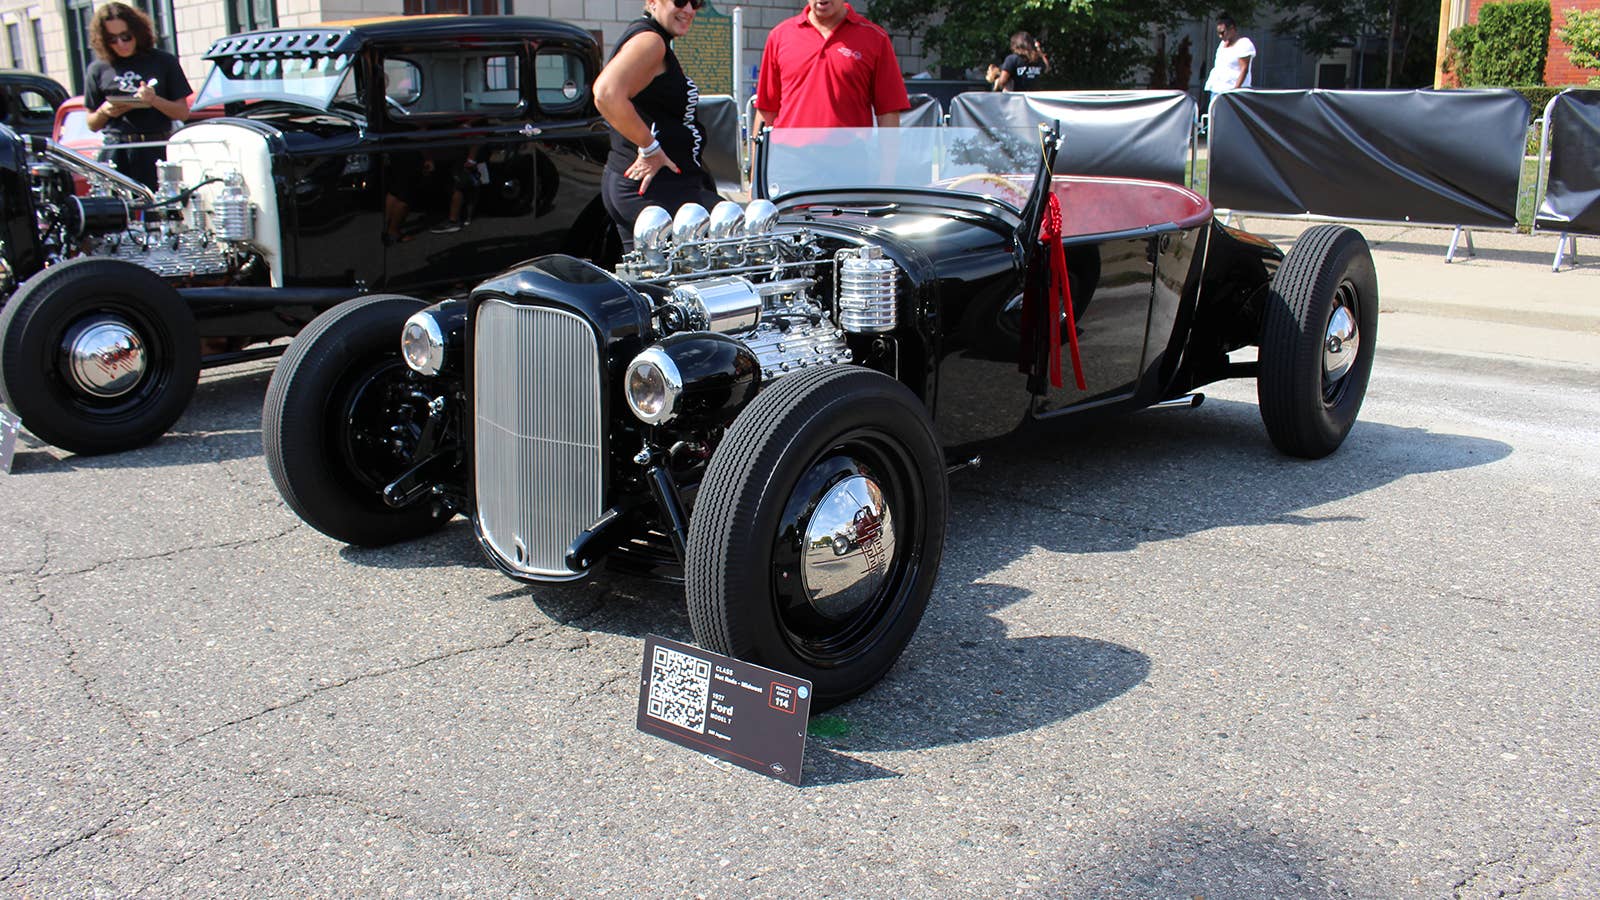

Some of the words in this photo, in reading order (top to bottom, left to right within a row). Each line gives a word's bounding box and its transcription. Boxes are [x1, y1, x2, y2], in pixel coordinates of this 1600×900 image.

[715, 665, 734, 676] CLASS
[714, 673, 725, 681] Hot
[725, 676, 738, 686] Rods
[712, 692, 725, 702] 1927
[711, 700, 734, 716] Ford
[775, 697, 789, 709] 114
[710, 713, 727, 724] MODEL
